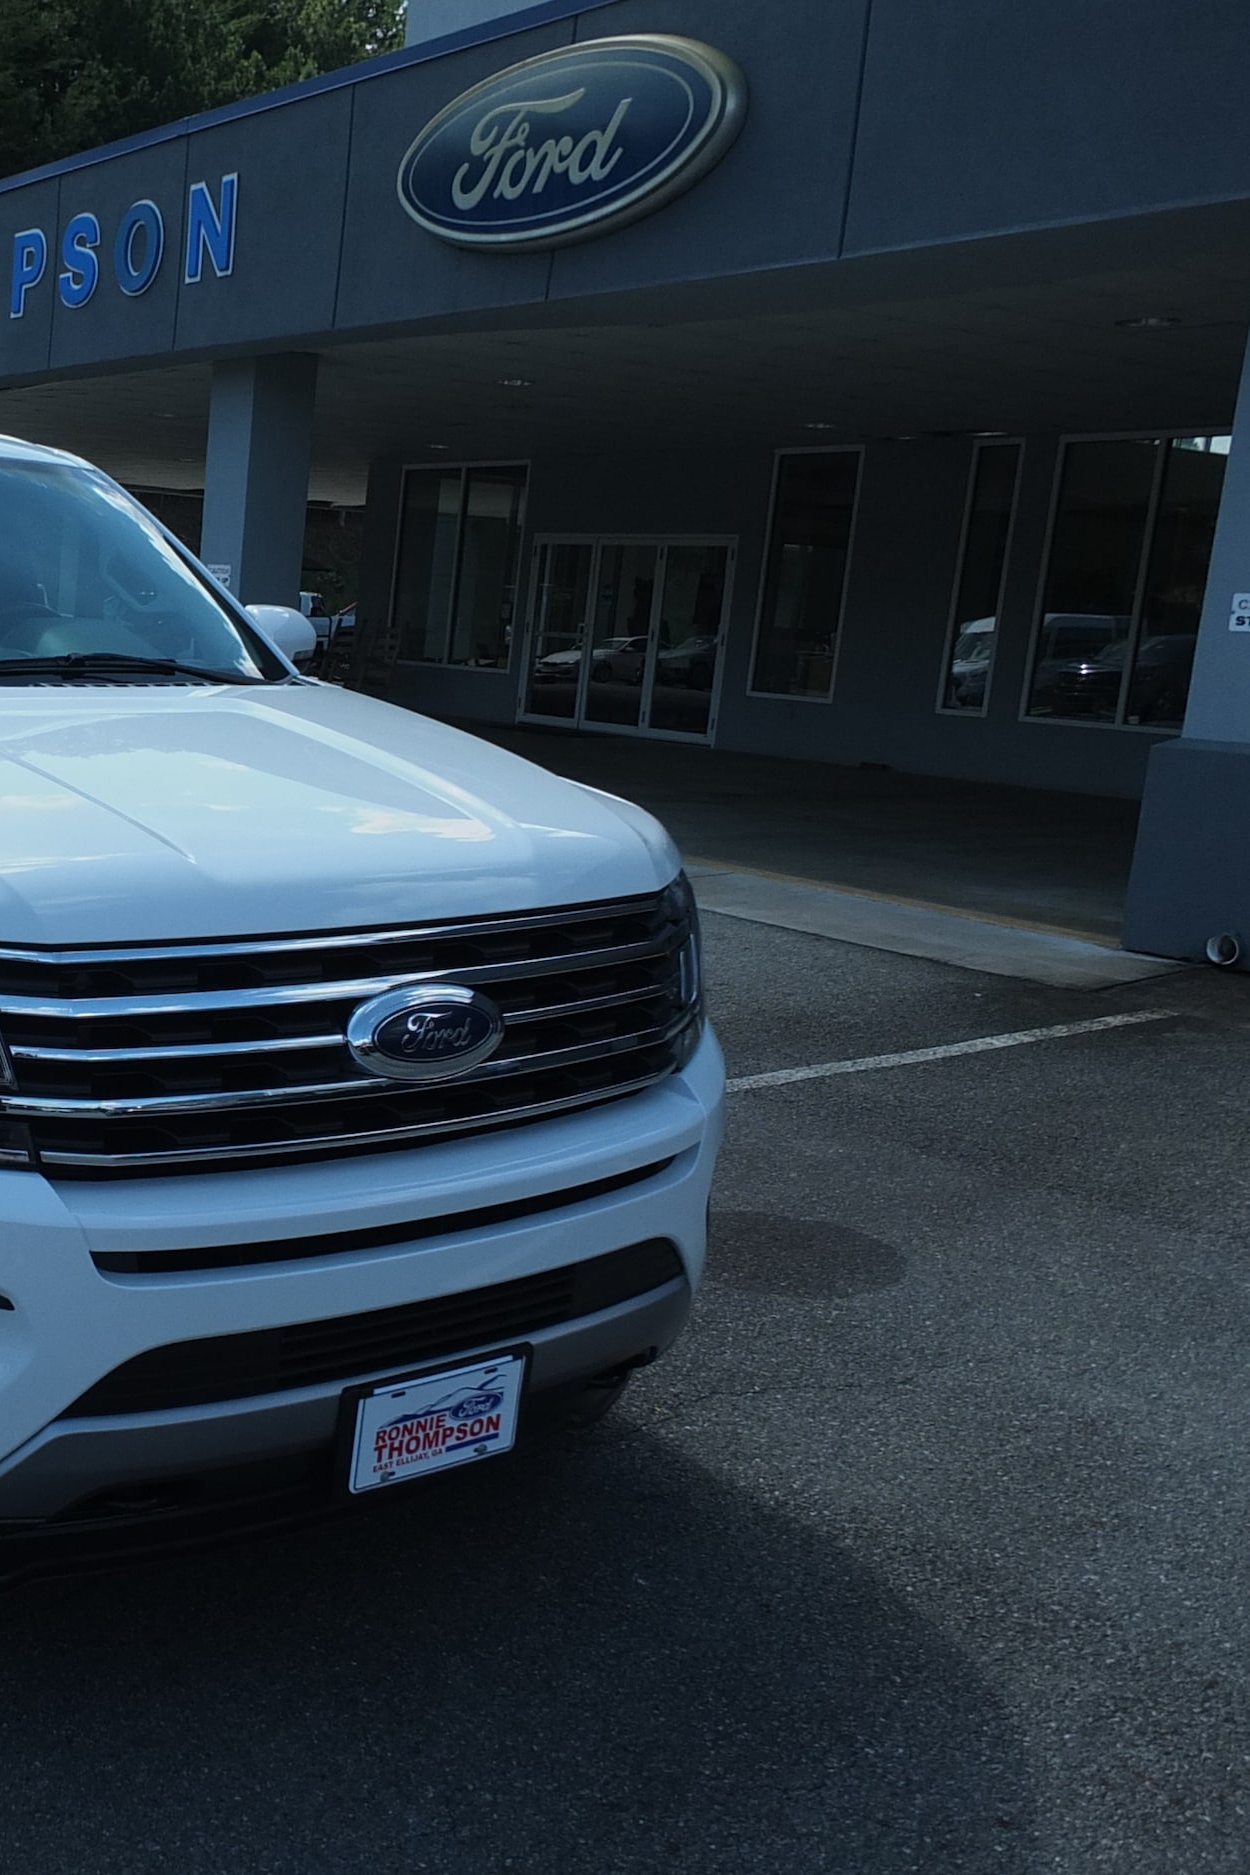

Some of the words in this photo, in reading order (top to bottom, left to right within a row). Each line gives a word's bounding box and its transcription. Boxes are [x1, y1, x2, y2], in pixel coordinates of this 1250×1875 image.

[452, 86, 632, 211] Ford
[401, 1011, 471, 1053] Ford
[458, 1397, 494, 1418] Ford
[373, 1414, 501, 1463] THOMPSON
[375, 1413, 447, 1445] RONNIE
[372, 1461, 394, 1473] EAST
[431, 1447, 444, 1457] GA
